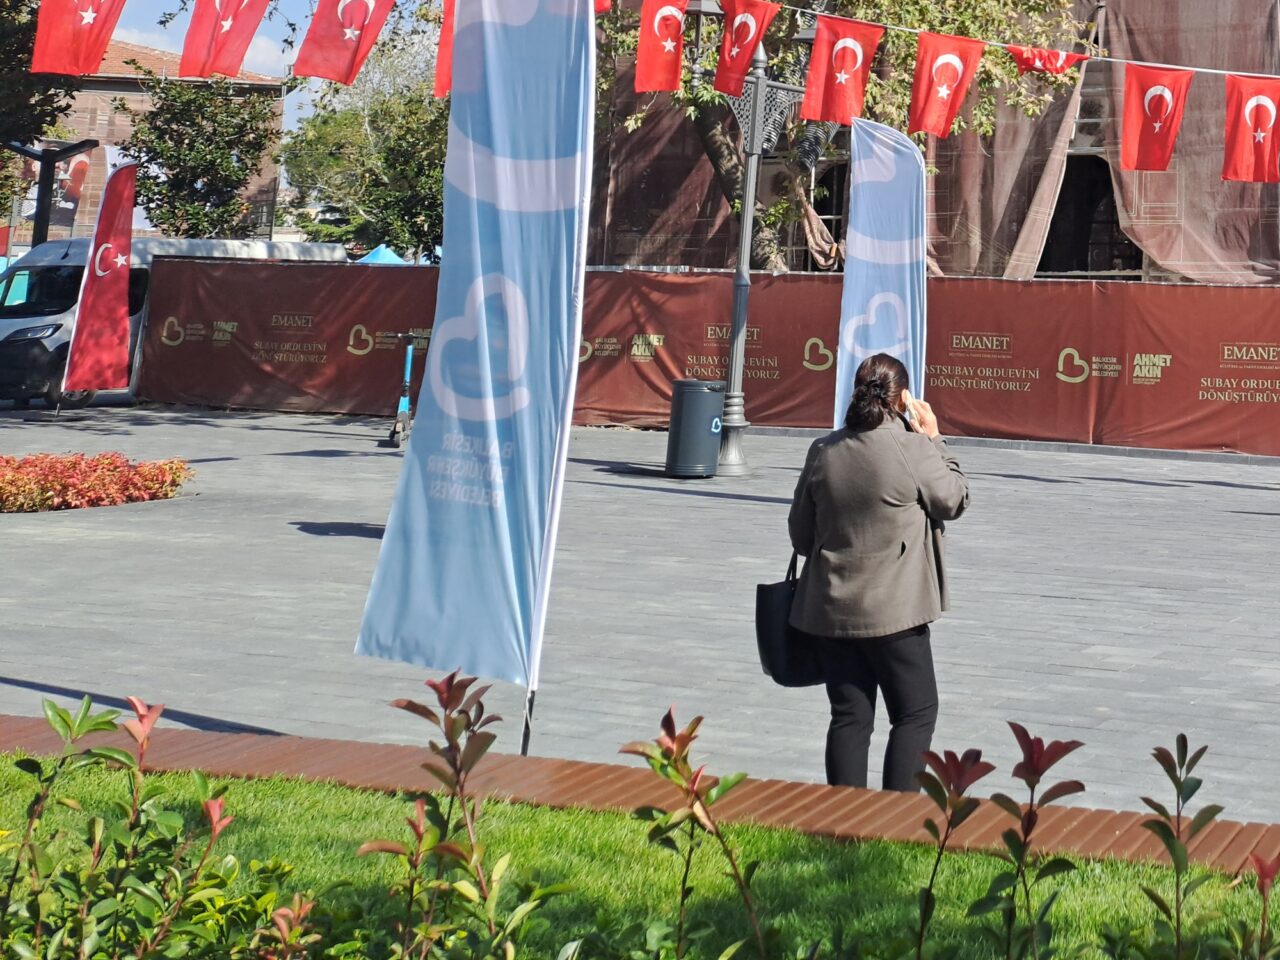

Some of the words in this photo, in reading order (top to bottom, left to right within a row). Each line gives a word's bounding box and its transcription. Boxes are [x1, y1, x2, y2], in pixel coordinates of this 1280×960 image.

[271, 314, 314, 327] EMANET
[707, 326, 760, 340] EMET
[631, 334, 665, 346] AHMET
[952, 335, 1010, 350] EMANET
[687, 355, 720, 365] SUBAY
[1133, 353, 1172, 367] AHMET
[977, 367, 1040, 380] ORDUEVİ'Nİ
[1132, 365, 1162, 378] AKIN
[930, 376, 1031, 392] DÖNÜŞTÜRÜYORUZ
[1200, 377, 1238, 388] SUBAY
